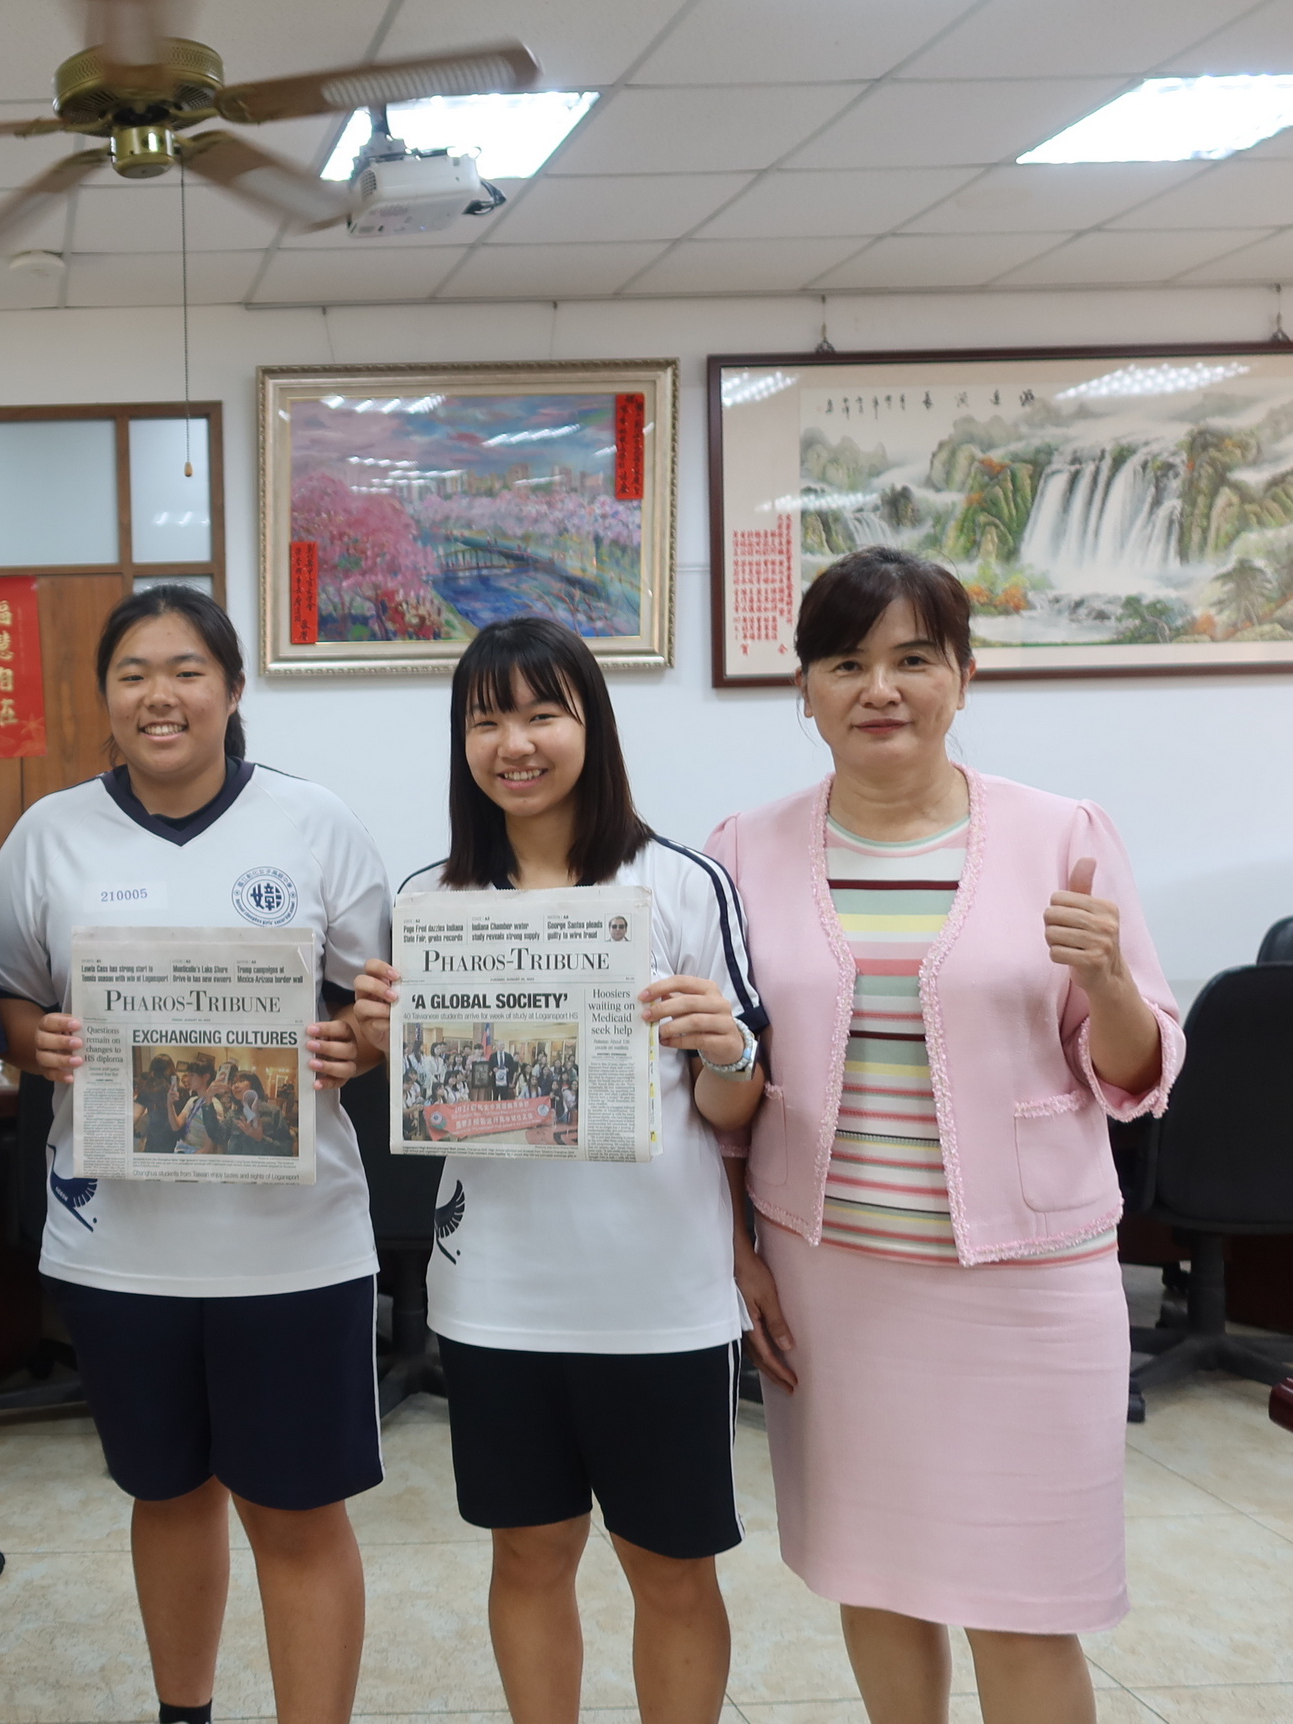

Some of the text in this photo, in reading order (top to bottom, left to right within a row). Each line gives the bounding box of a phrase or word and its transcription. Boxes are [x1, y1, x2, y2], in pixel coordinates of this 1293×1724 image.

[101, 888, 147, 902] 210005
[422, 948, 609, 972] PHAROS-TRIBUNE
[593, 989, 630, 998] Hoosiers
[105, 989, 281, 1012] PHAROS-TRIBUNE
[431, 994, 491, 1009] GLOBAL
[588, 1001, 621, 1012] waiting
[489, 1012, 504, 1020] week
[506, 1012, 512, 1020] of
[513, 1012, 527, 1021] study
[535, 1012, 568, 1021] Logansport
[592, 1013, 632, 1022] Medicaid
[87, 1026, 119, 1035] Questions
[591, 1025, 632, 1037] seek help
[133, 1030, 297, 1045] EXCHANGING CULTURES
[86, 1045, 112, 1054] changes
[97, 1055, 123, 1064] diploma
